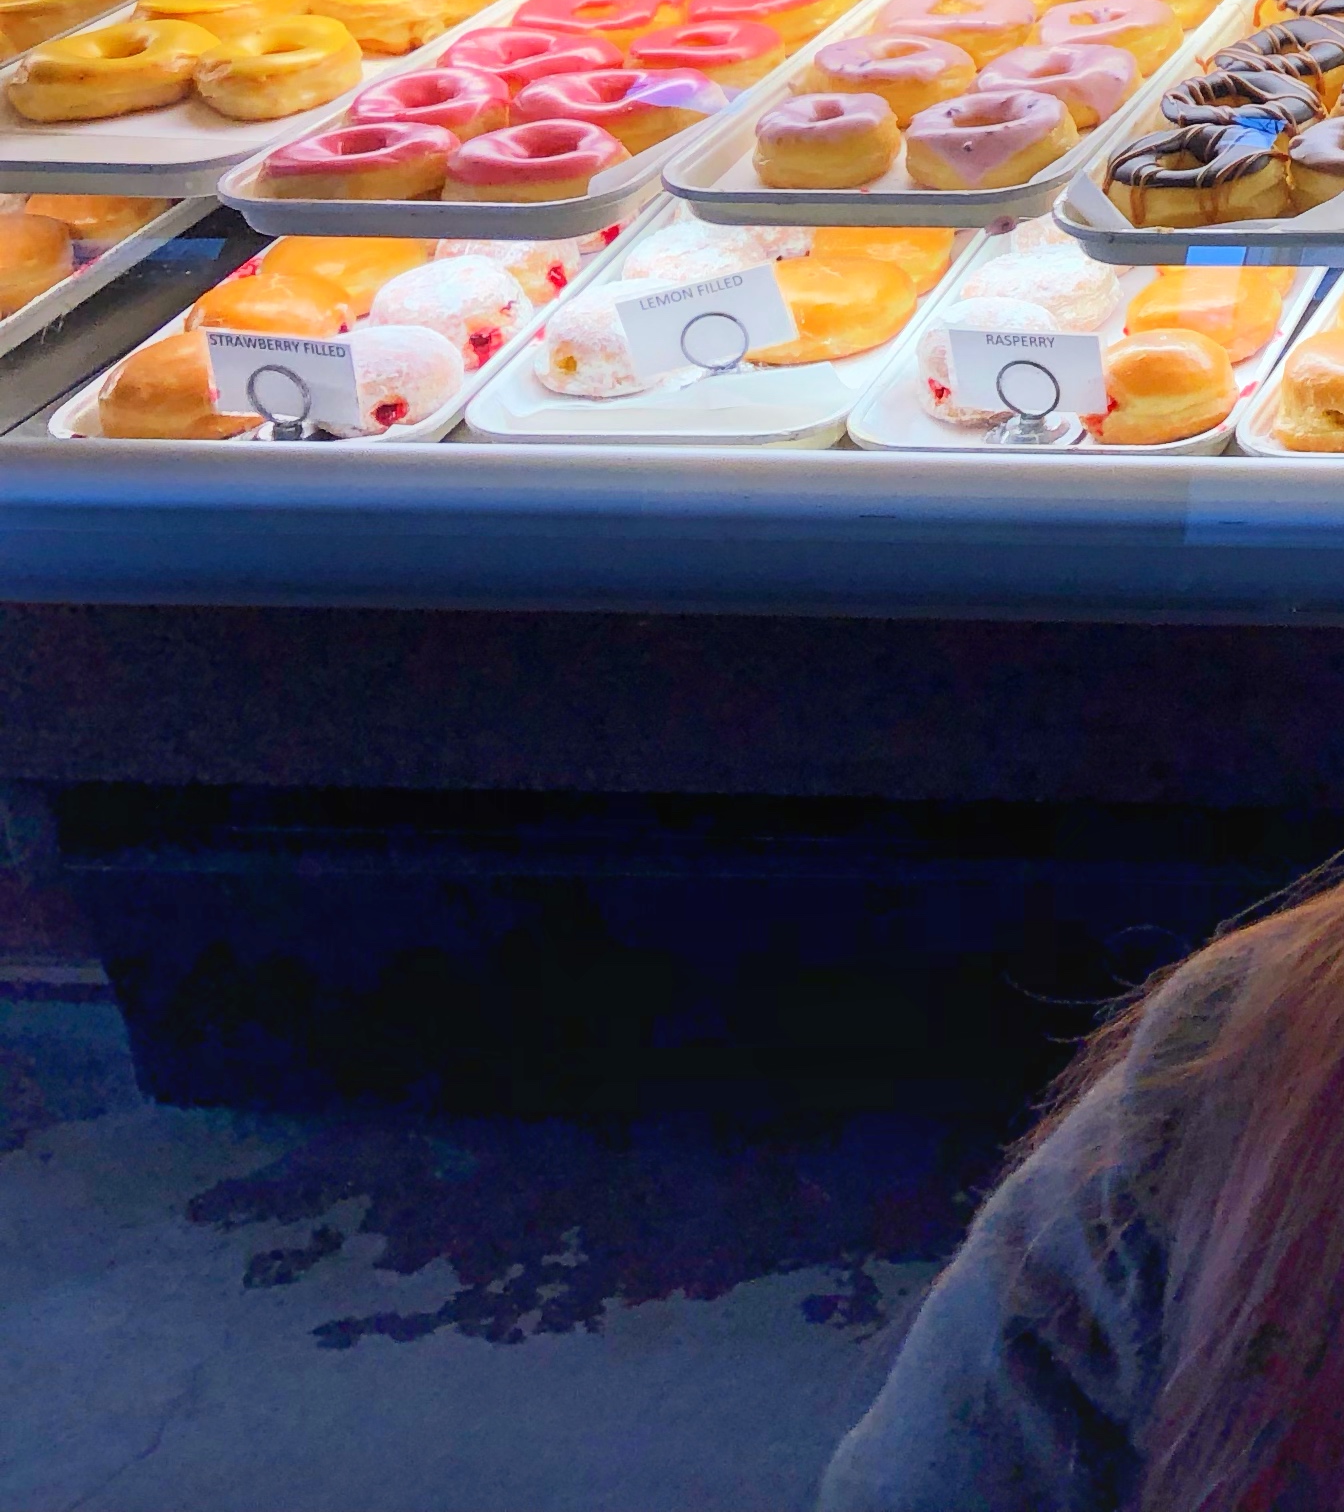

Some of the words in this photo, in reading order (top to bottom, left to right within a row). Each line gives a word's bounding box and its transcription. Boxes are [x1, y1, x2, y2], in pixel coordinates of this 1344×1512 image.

[638, 287, 694, 311] LEMON
[696, 275, 744, 296] FILLED
[209, 333, 300, 354] STRAWBERRY
[303, 342, 346, 358] FILLED
[985, 334, 1055, 348] RASPERRY
